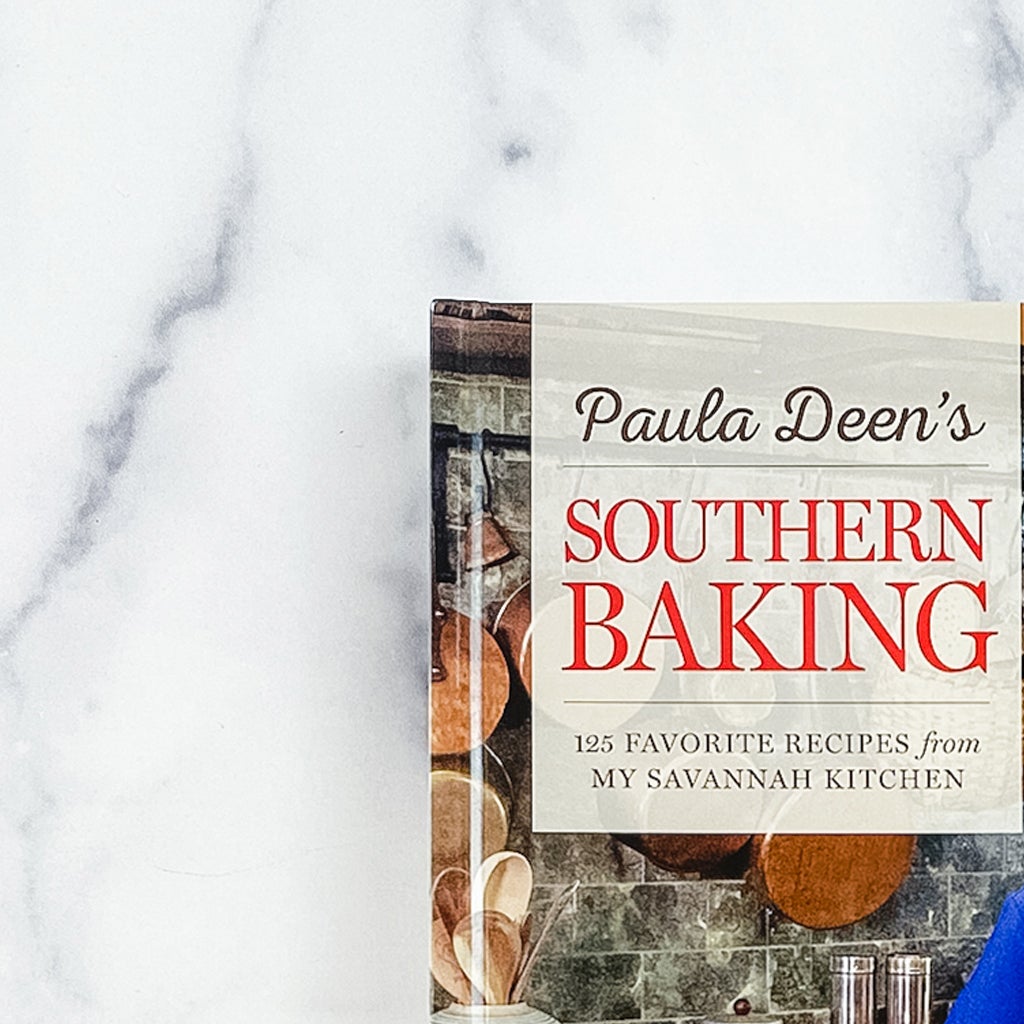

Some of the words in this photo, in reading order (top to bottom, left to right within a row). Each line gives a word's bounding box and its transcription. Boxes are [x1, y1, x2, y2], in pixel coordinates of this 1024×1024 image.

[575, 386, 762, 443] Paula
[774, 385, 987, 443] Deen's
[563, 497, 992, 564] SOUTHERN
[562, 579, 998, 674] BAKING
[574, 733, 614, 755] 125
[625, 732, 775, 755] FAVORITE
[784, 732, 910, 756] RECIPES
[914, 730, 981, 761] from
[591, 767, 637, 789] MY
[646, 767, 812, 790] SAVANNAH
[824, 768, 965, 791] KITCHEN
